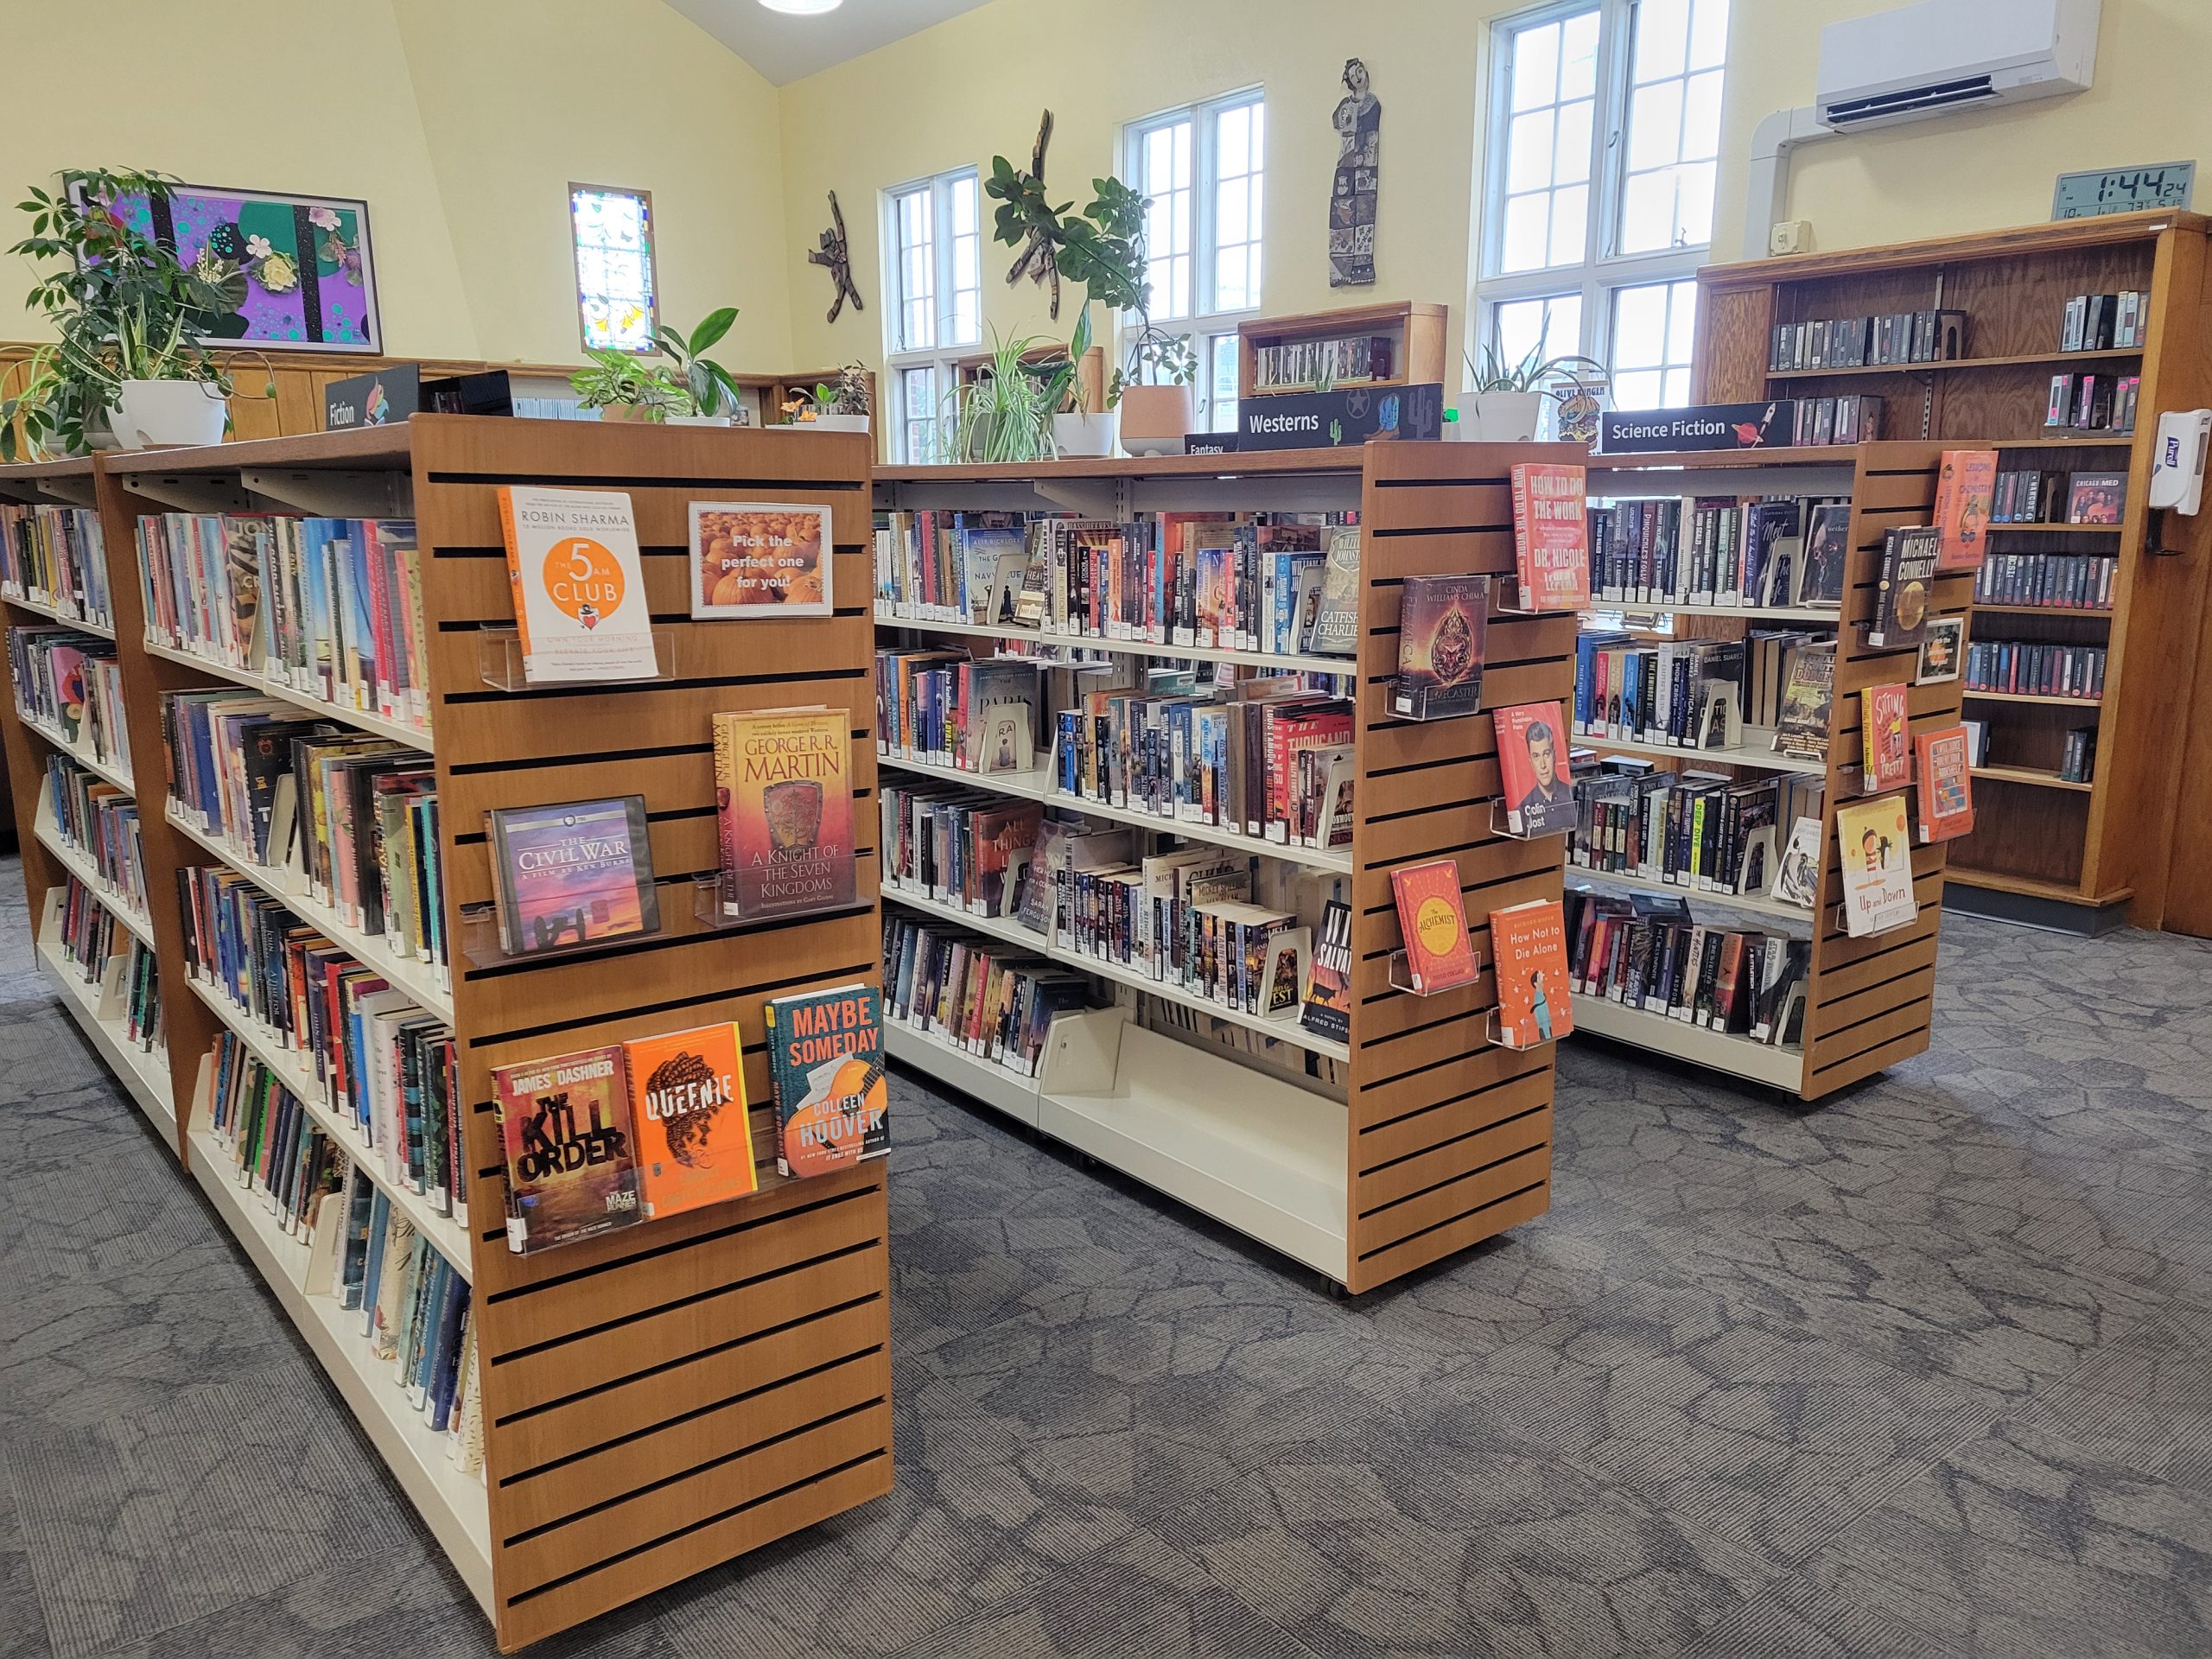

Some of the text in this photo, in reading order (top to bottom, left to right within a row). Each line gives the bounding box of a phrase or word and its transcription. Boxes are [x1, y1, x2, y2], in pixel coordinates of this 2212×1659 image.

[2098, 170, 2186, 202] 1:44 24
[1578, 387, 1605, 397] BRGER
[330, 401, 354, 426] Fiction
[1249, 415, 1319, 434] Westerns
[1612, 420, 1726, 440] Science Fiction
[1191, 444, 1224, 454] Fantasy
[2166, 441, 2178, 466] Purell
[1530, 476, 1583, 497] HOW TO DO
[2028, 482, 2037, 511] NARCOS
[522, 511, 629, 525] ROBIN SHARMA
[1514, 469, 1527, 557] HOW TO DO THE WORK
[1534, 500, 1582, 520] THE WORK
[733, 535, 793, 547] Pick the
[1640, 514, 1652, 582] PINQUICKLE'S FOLLY
[1901, 537, 1938, 558] MICHAEL
[569, 543, 593, 582] 5
[594, 566, 612, 575] AM
[721, 556, 804, 570] perfect one
[1534, 548, 1585, 568] DR. NICOLE
[1897, 558, 1936, 581] CONNELLY
[553, 582, 617, 602] CLUB
[736, 576, 790, 590] for you!
[1446, 585, 1468, 594] CINDA
[1426, 592, 1484, 603] WILLIAMS CHIMA
[1320, 611, 1358, 624] CATFISH
[1704, 652, 1744, 664] DANIEL SUAREZ
[1875, 692, 1904, 725] SITTING
[1287, 721, 1319, 732] THE
[713, 723, 723, 782] MARTIN
[745, 734, 838, 755] GEORGE R. R.
[745, 752, 839, 782] MARTIN
[1524, 803, 1546, 816] Colin
[1005, 819, 1025, 833] ALL
[1527, 817, 1545, 829] Jost
[560, 836, 586, 847] THE
[519, 842, 629, 870] CIVIL WAR
[601, 858, 631, 868] BURNS
[751, 844, 839, 867] A KNIGHT OF
[763, 861, 830, 881] THE SEVEN
[761, 877, 832, 898] KINGDOMS
[1030, 899, 1050, 912] SARAH
[1859, 888, 1905, 913] Up and Down
[1419, 914, 1455, 933] ALCHEMIST
[266, 930, 275, 952] JOHN
[1510, 926, 1560, 944] How Not to
[1515, 943, 1558, 960] Die Alone
[1670, 975, 1680, 1005] ANDRONE
[792, 996, 873, 1039] MAYBE
[1303, 1014, 1329, 1027] ALFRED
[314, 1039, 322, 1070] IRVING
[790, 1027, 878, 1066] SOMEDAY
[512, 1073, 552, 1096] JAMES
[556, 1060, 614, 1086] DASHNER
[418, 1081, 427, 1124] JEWELL
[645, 1074, 734, 1121] QUEENIE
[814, 1093, 864, 1116] COLLEEN
[519, 1099, 617, 1154] KILL
[799, 1108, 883, 1147] HOOVER
[517, 1131, 629, 1183] ORDER
[606, 1190, 635, 1205] MAZE
